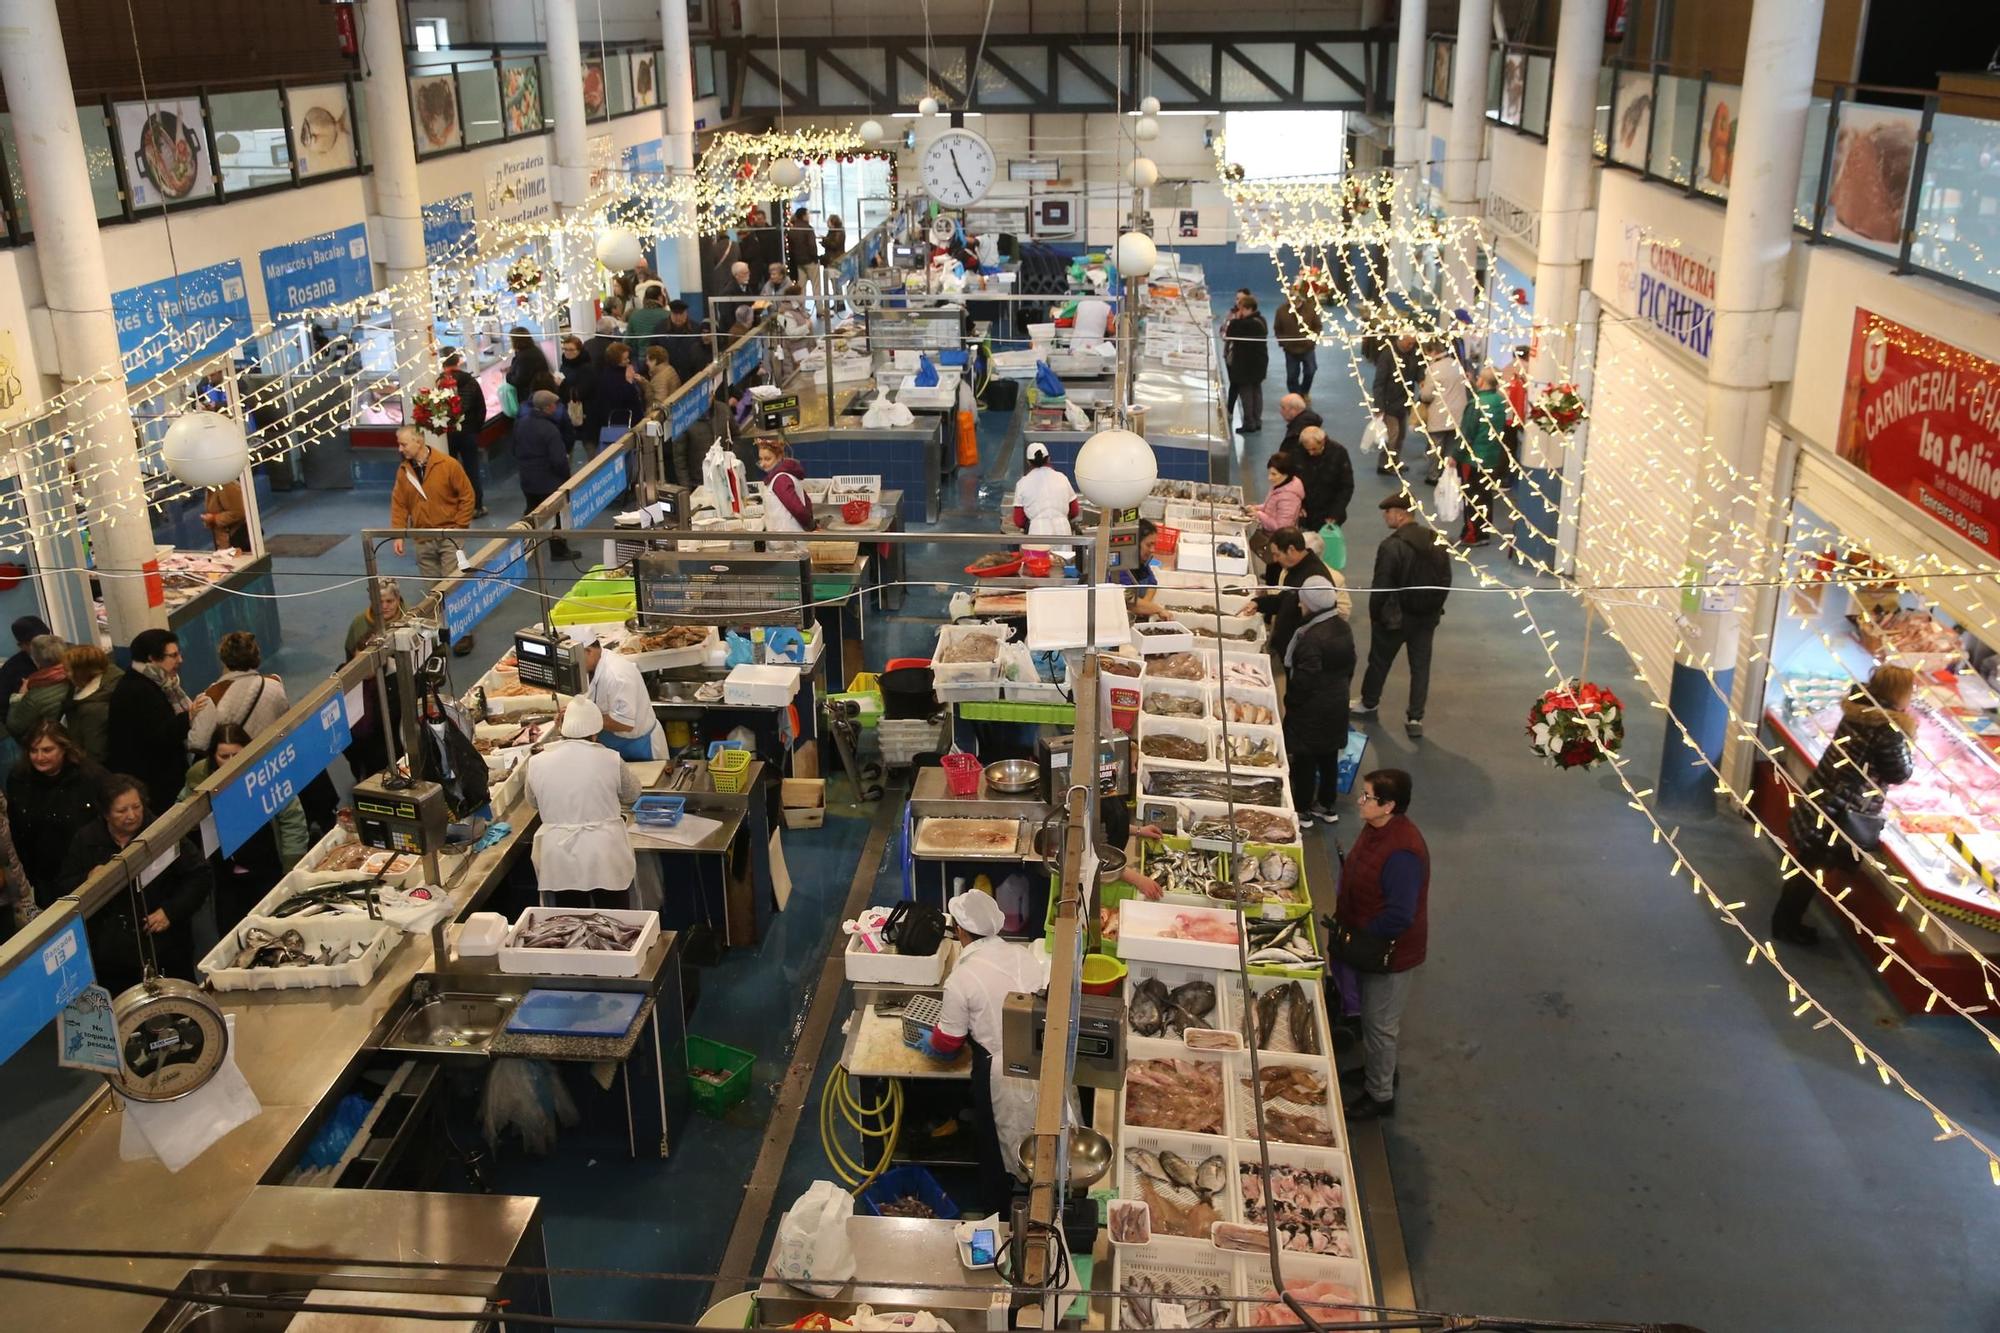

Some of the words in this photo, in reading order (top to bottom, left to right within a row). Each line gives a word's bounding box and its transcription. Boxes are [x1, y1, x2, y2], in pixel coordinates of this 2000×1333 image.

[266, 257, 306, 279] Mariscos
[306, 256, 313, 270] y
[313, 245, 346, 265] Bacalao
[157, 289, 220, 320] Mariscos
[288, 277, 337, 308] Rosana
[1918, 417, 1944, 468] Isa
[245, 743, 296, 798] Peixes
[261, 779, 293, 814] Lita
[54, 949, 66, 967] 13
